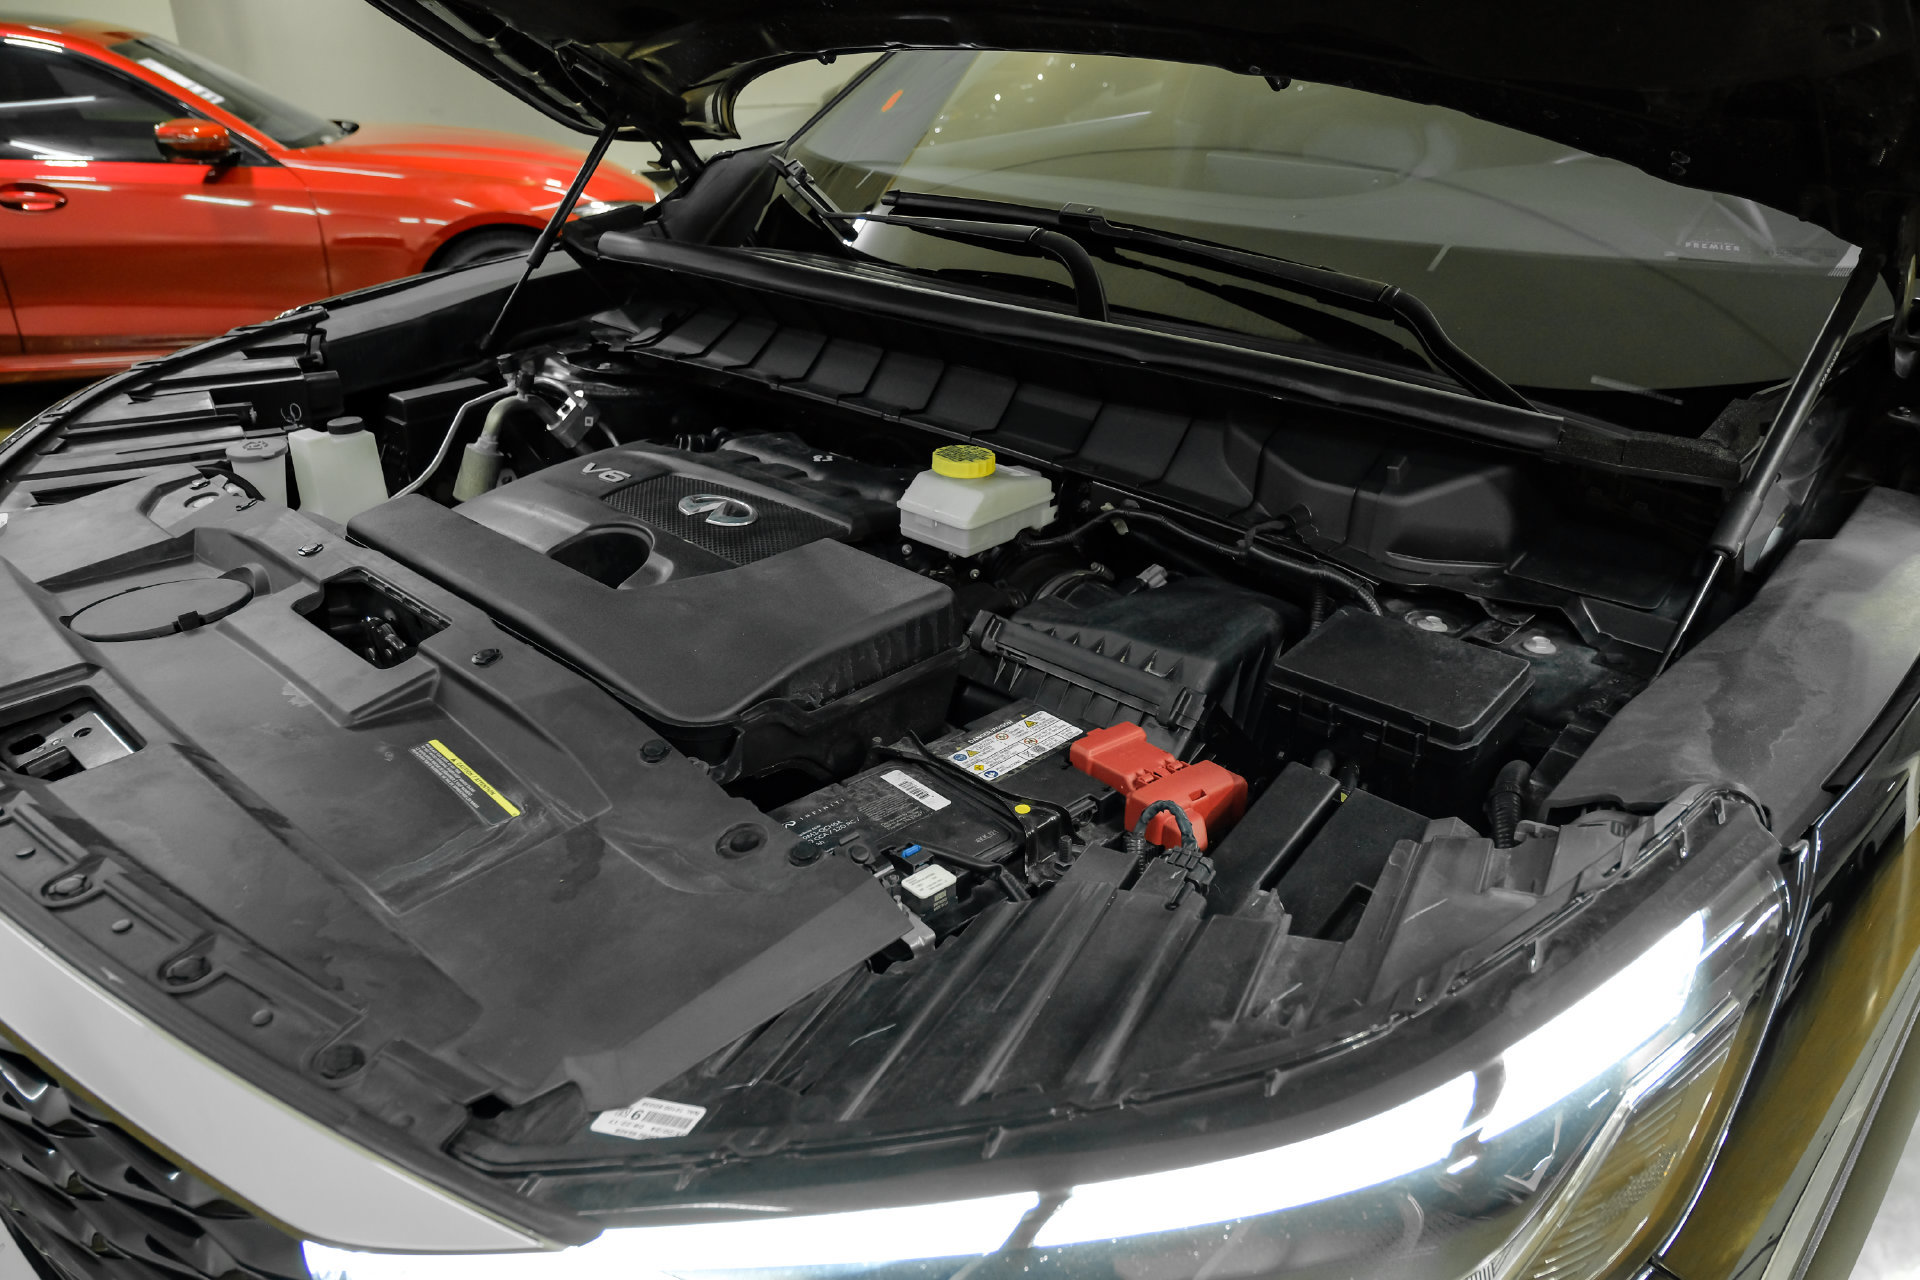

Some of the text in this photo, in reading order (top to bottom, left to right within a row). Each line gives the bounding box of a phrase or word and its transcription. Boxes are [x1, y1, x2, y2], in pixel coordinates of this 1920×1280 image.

[1685, 241, 1740, 252] PREMIER
[582, 462, 632, 483] V6
[456, 762, 473, 776] CAUTION
[800, 798, 845, 821] INFINITI
